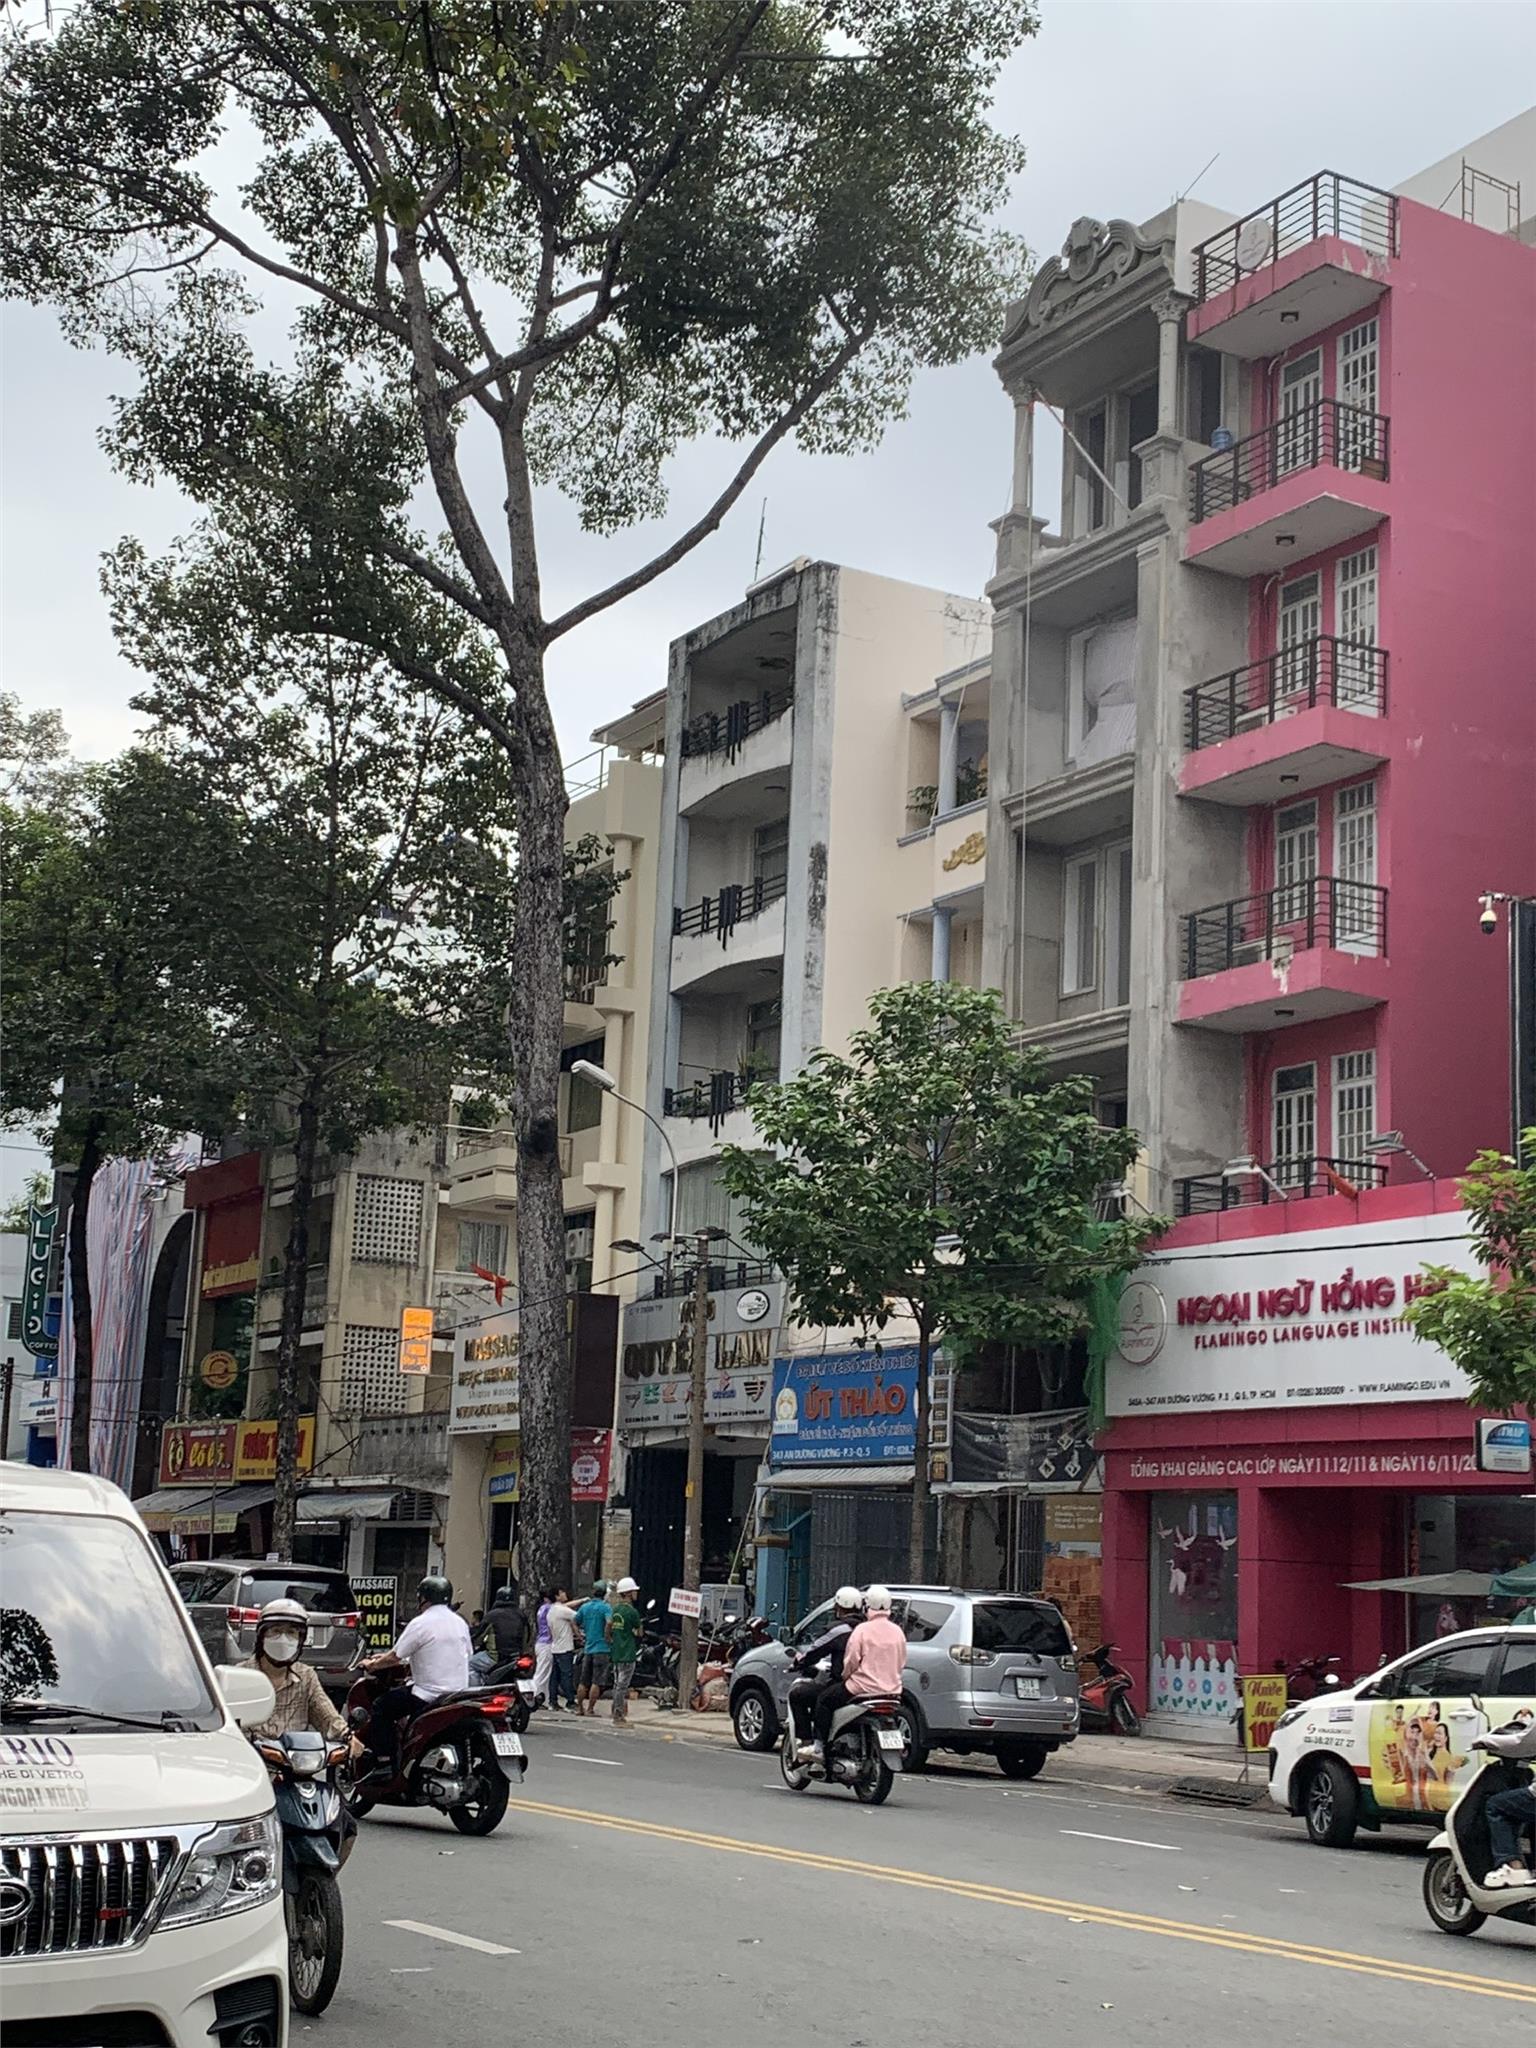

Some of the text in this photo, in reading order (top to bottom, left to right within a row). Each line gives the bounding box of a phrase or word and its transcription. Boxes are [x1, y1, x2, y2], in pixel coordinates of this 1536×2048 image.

[1177, 1292, 1250, 1327] NGOẠI
[1257, 1279, 1316, 1319] NGỮ
[464, 1332, 521, 1361] MASSAG
[1194, 1331, 1268, 1350] FLAMINGO
[1273, 1321, 1360, 1343] LANGUAGE
[715, 1328, 771, 1369] LAN
[839, 1375, 908, 1418] THẢO
[1161, 1461, 1186, 1477] KHAI
[352, 1579, 394, 1590] MASSAGE
[366, 1613, 389, 1626] NH
[370, 1633, 391, 1646] AR
[20, 1769, 34, 1779] DI
[35, 1769, 84, 1780] VETRO
